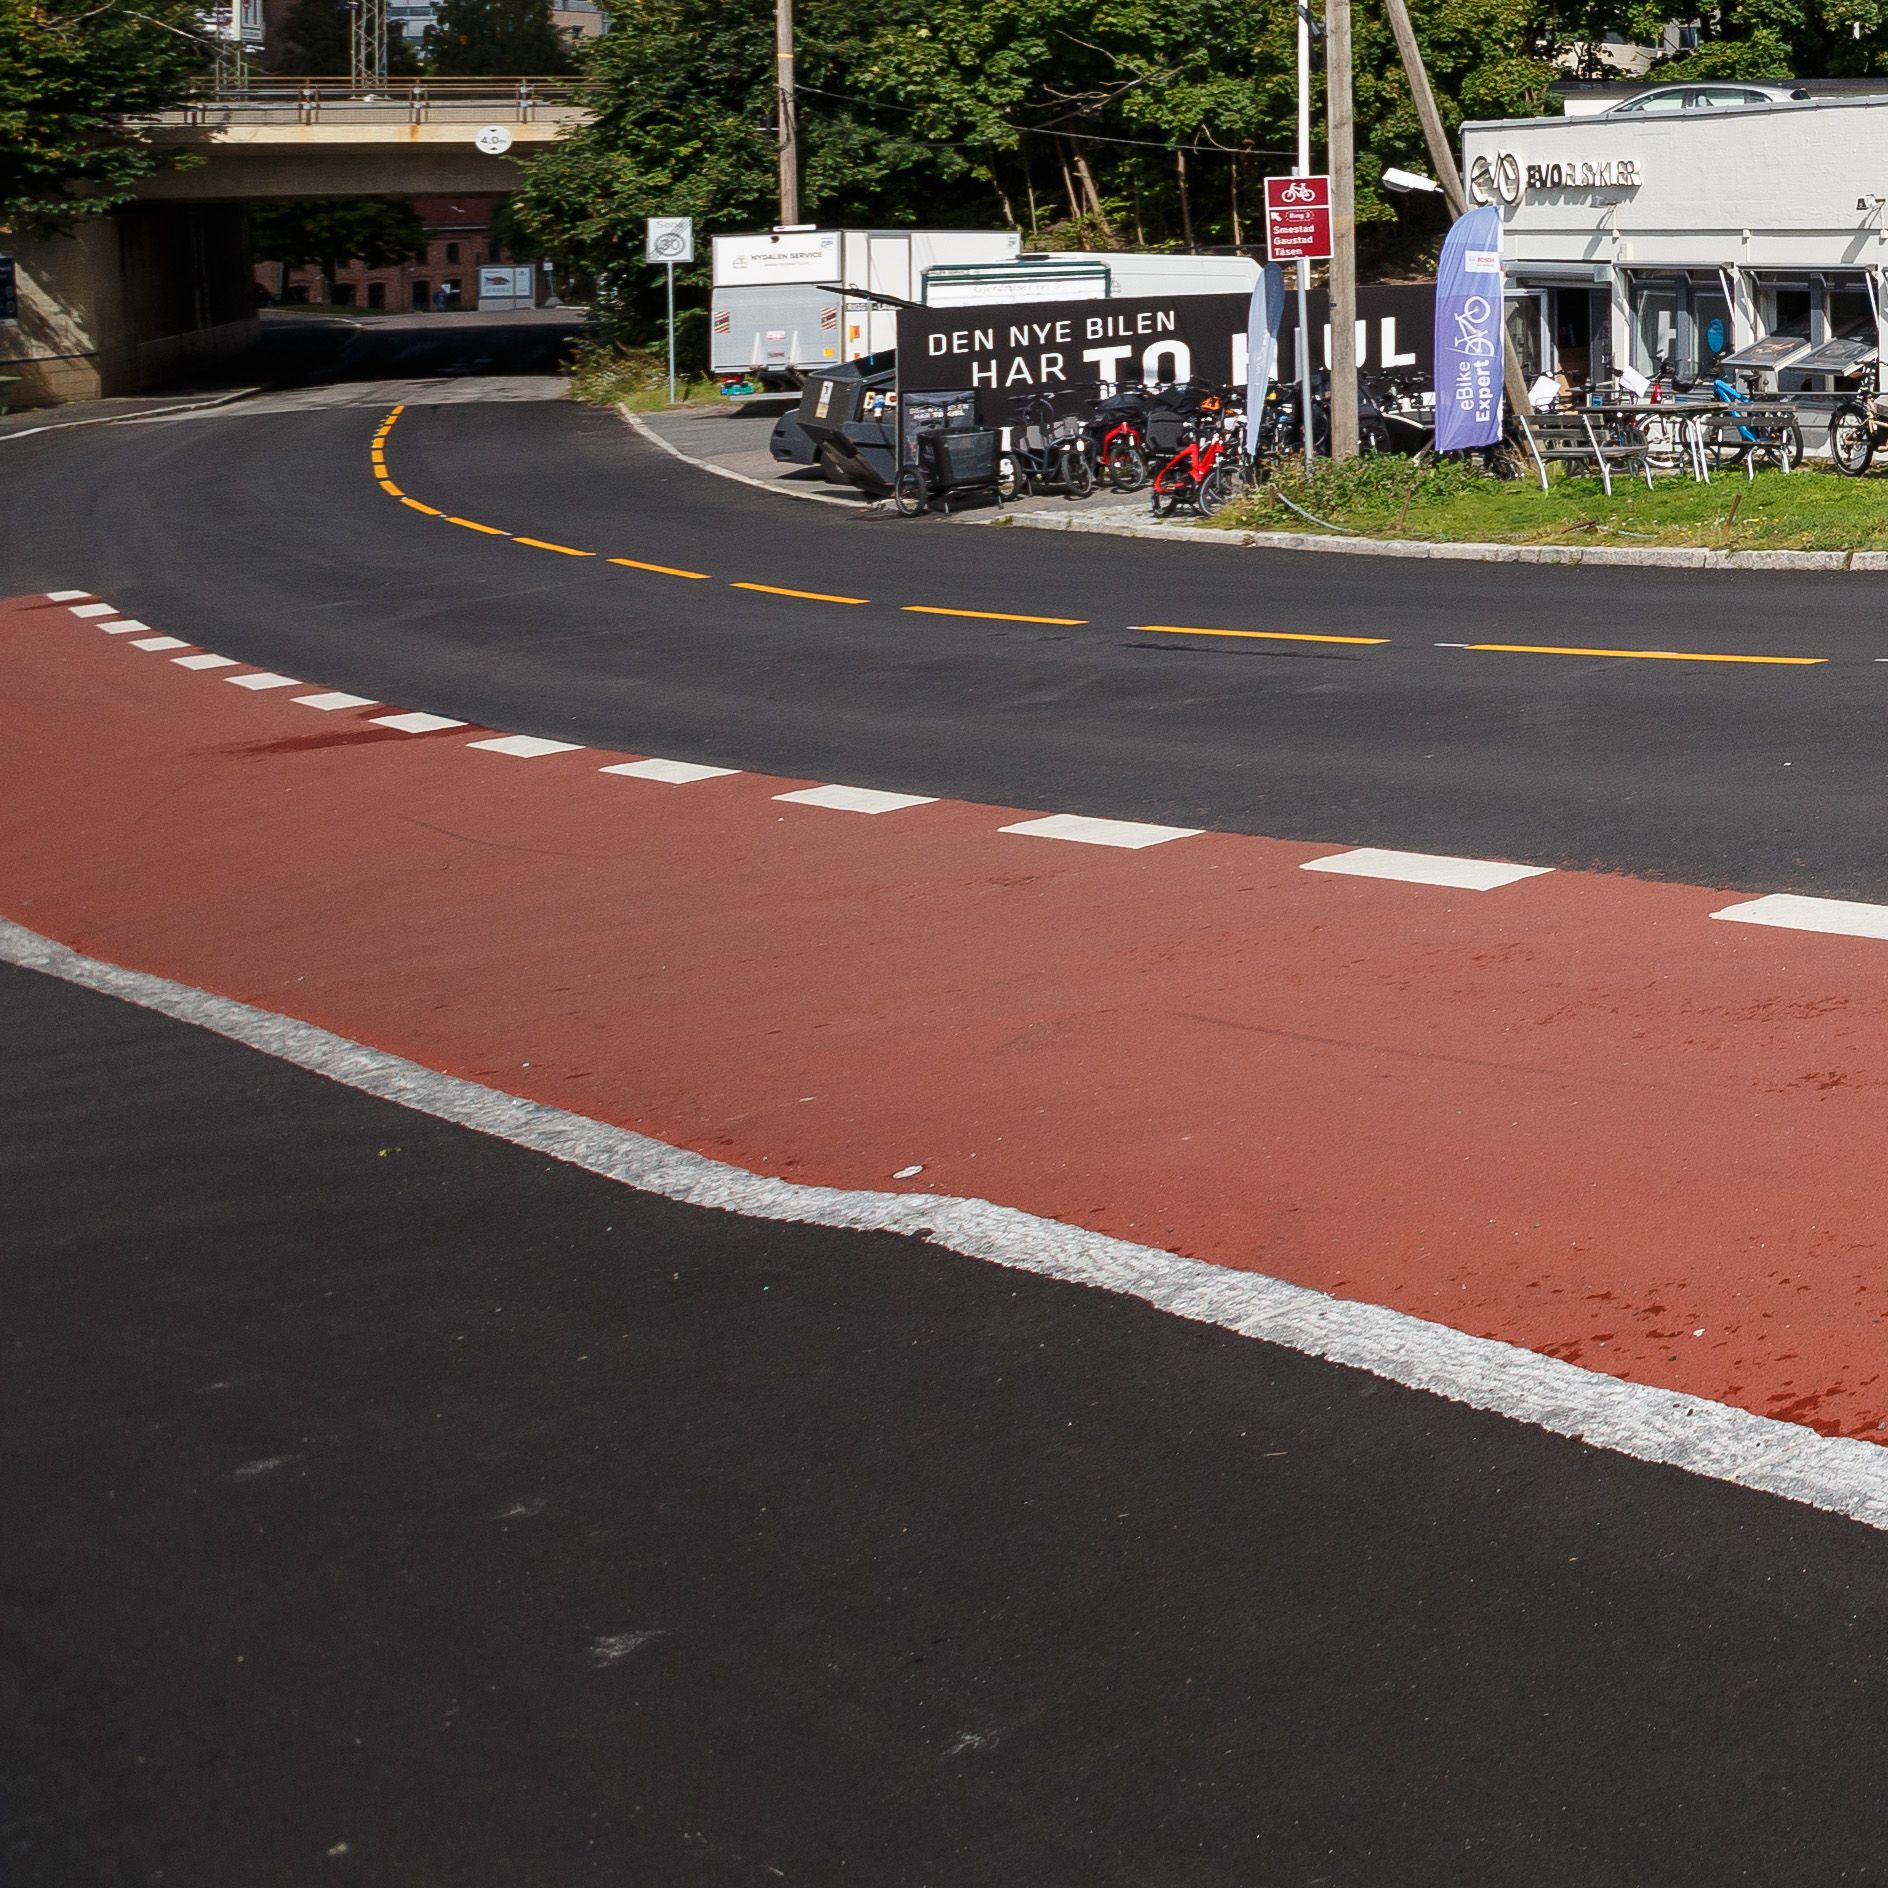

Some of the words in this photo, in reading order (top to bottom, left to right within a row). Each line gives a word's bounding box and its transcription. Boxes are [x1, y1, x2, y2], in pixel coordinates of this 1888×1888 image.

[1273, 224, 1315, 234] Smestad
[1288, 212, 1305, 220] Ring
[1305, 211, 1311, 219] 3
[1273, 235, 1313, 245] Gaustad
[928, 328, 994, 356] DEN
[1010, 320, 1072, 348] NYE
[1086, 310, 1175, 340] BILEN
[971, 352, 1067, 389] HAR
[1082, 339, 1191, 400] TO
[1231, 317, 1417, 386] HUL
[1456, 361, 1475, 411] eBike
[1473, 359, 1490, 423] Expert
